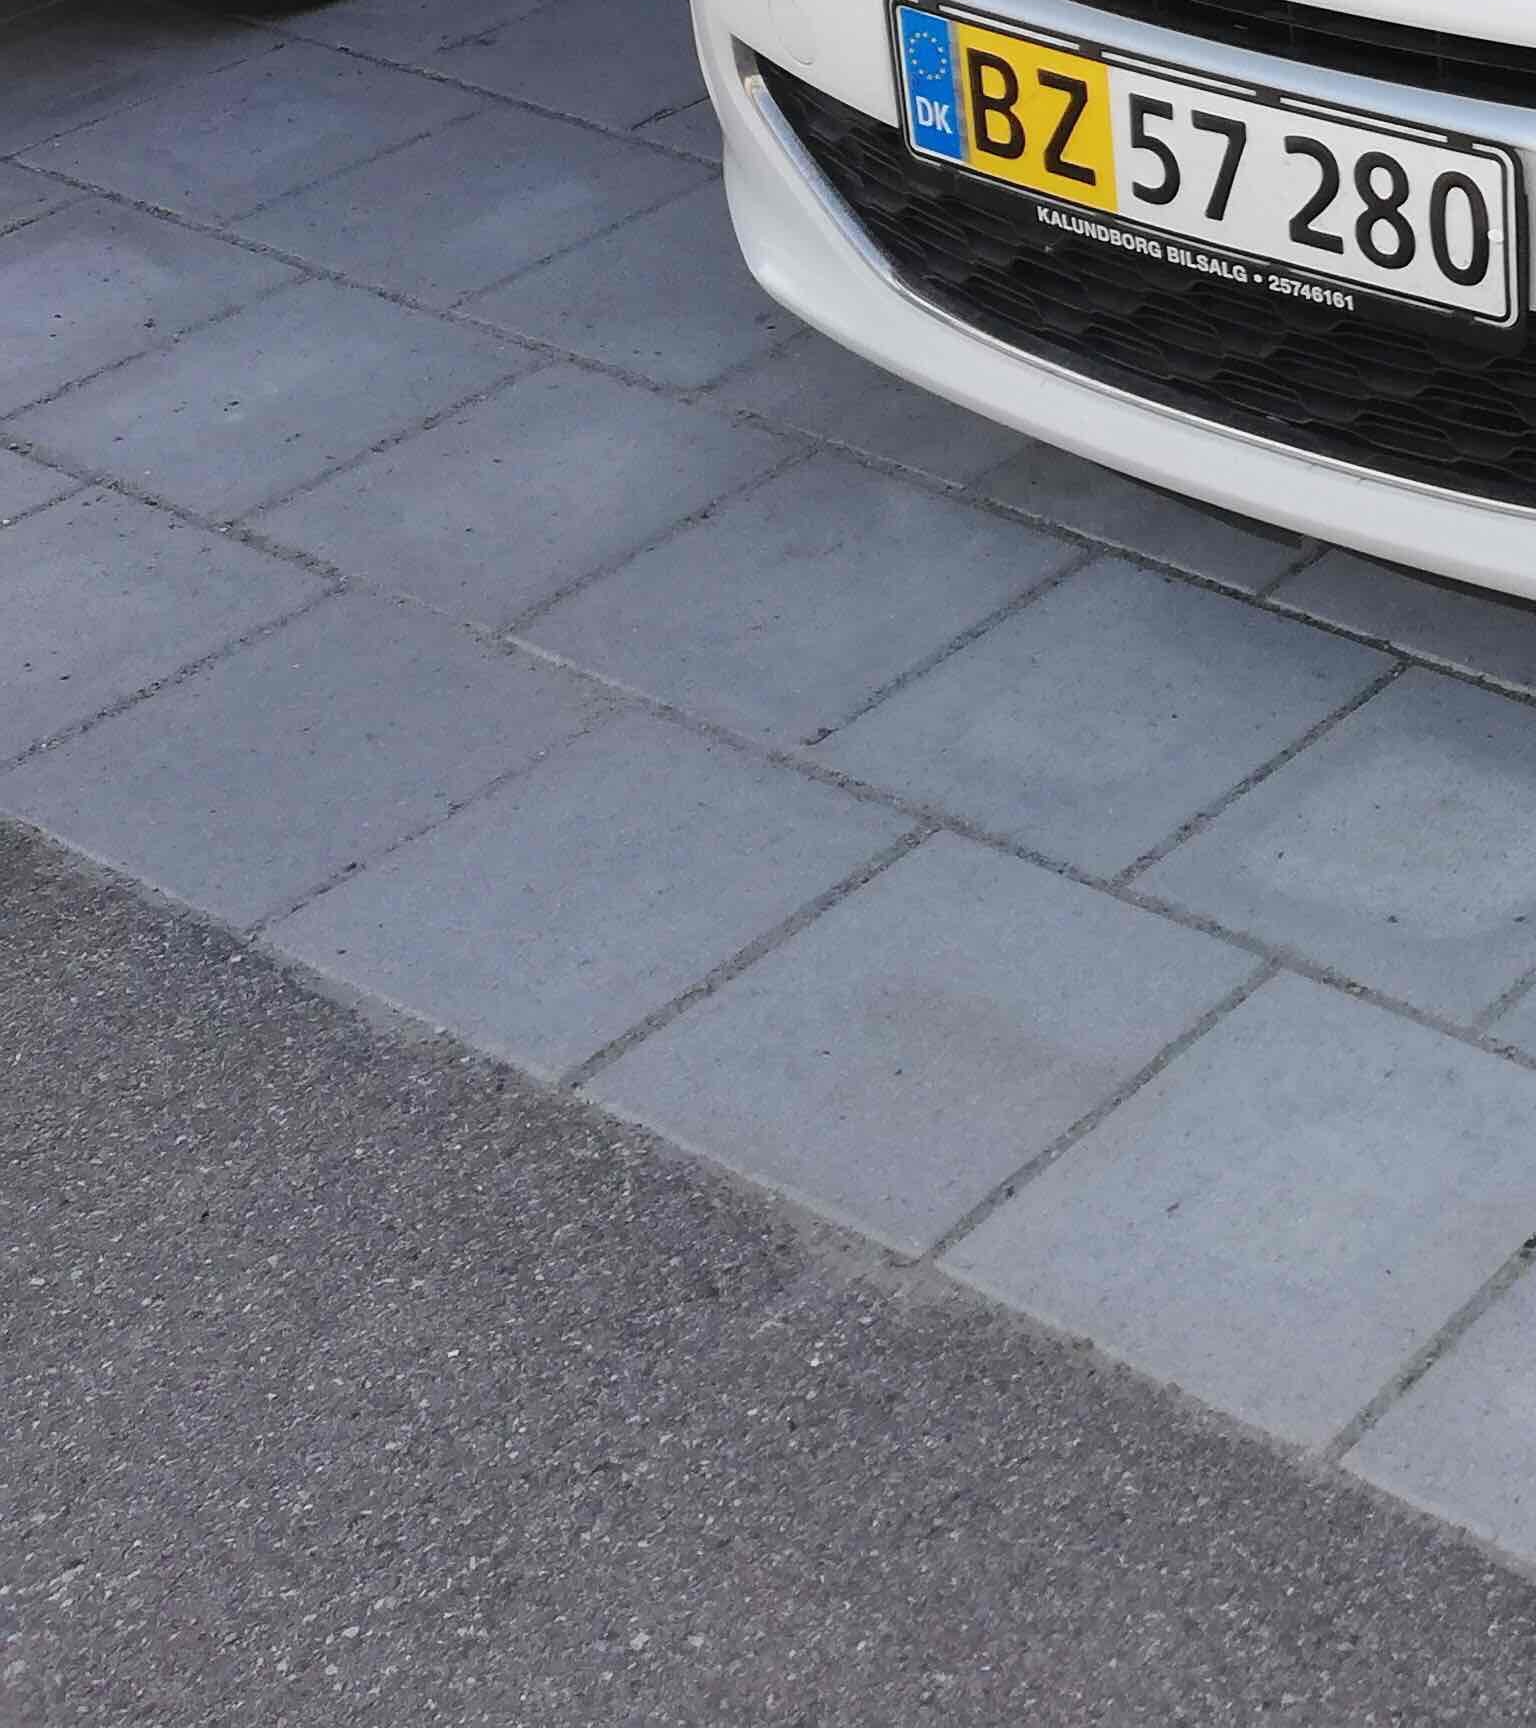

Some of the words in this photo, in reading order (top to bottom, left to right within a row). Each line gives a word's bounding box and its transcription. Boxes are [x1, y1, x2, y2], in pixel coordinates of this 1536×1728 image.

[915, 95, 953, 134] DK
[967, 47, 1097, 187] BZ
[1129, 92, 1247, 221] 57
[1284, 135, 1491, 287] 280
[1036, 205, 1163, 260] KALUNDBORG
[1166, 245, 1249, 284] BILSALG
[1268, 274, 1355, 311] 25746161
